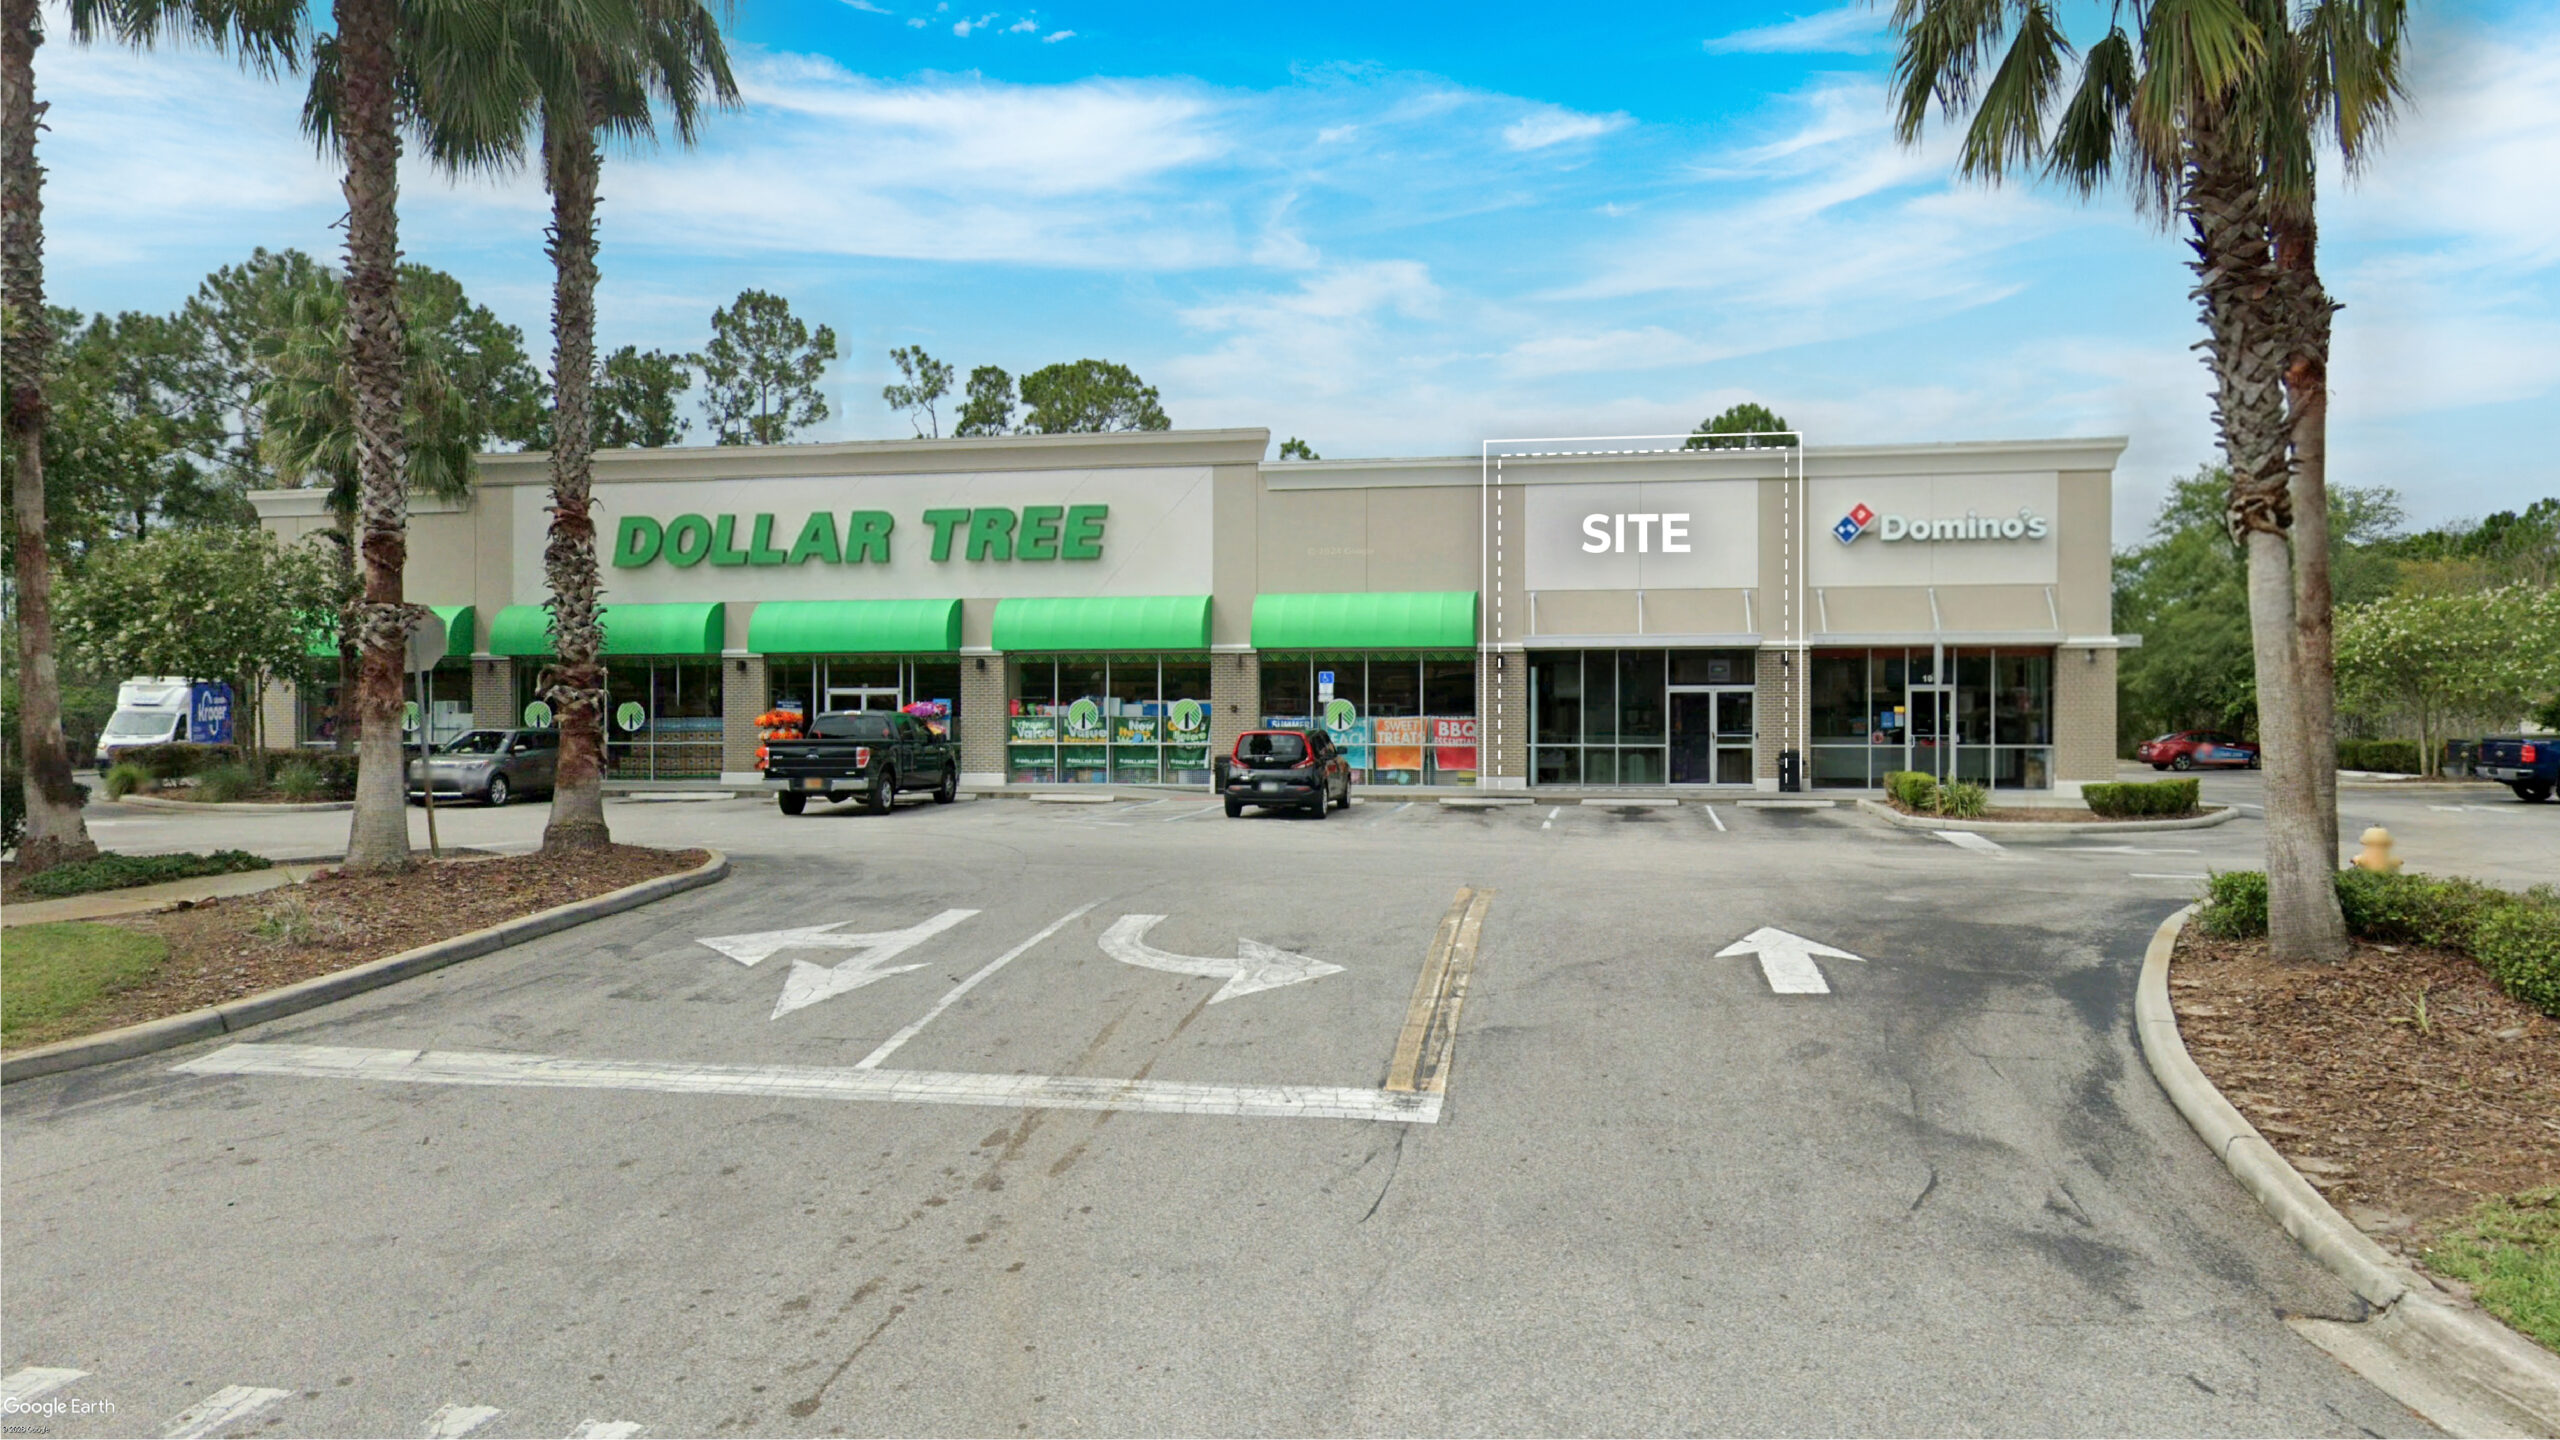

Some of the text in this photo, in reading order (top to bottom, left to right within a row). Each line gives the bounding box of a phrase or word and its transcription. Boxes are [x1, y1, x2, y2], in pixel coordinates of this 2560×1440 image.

[1880, 506, 2048, 542] Domino's
[613, 505, 1110, 568] DOLLAR TREE
[198, 690, 228, 736] Kroger
[1128, 720, 1155, 731] New
[1384, 720, 1418, 731] SWEET
[1438, 721, 1477, 737] BBQ
[1330, 733, 1367, 744] EACH
